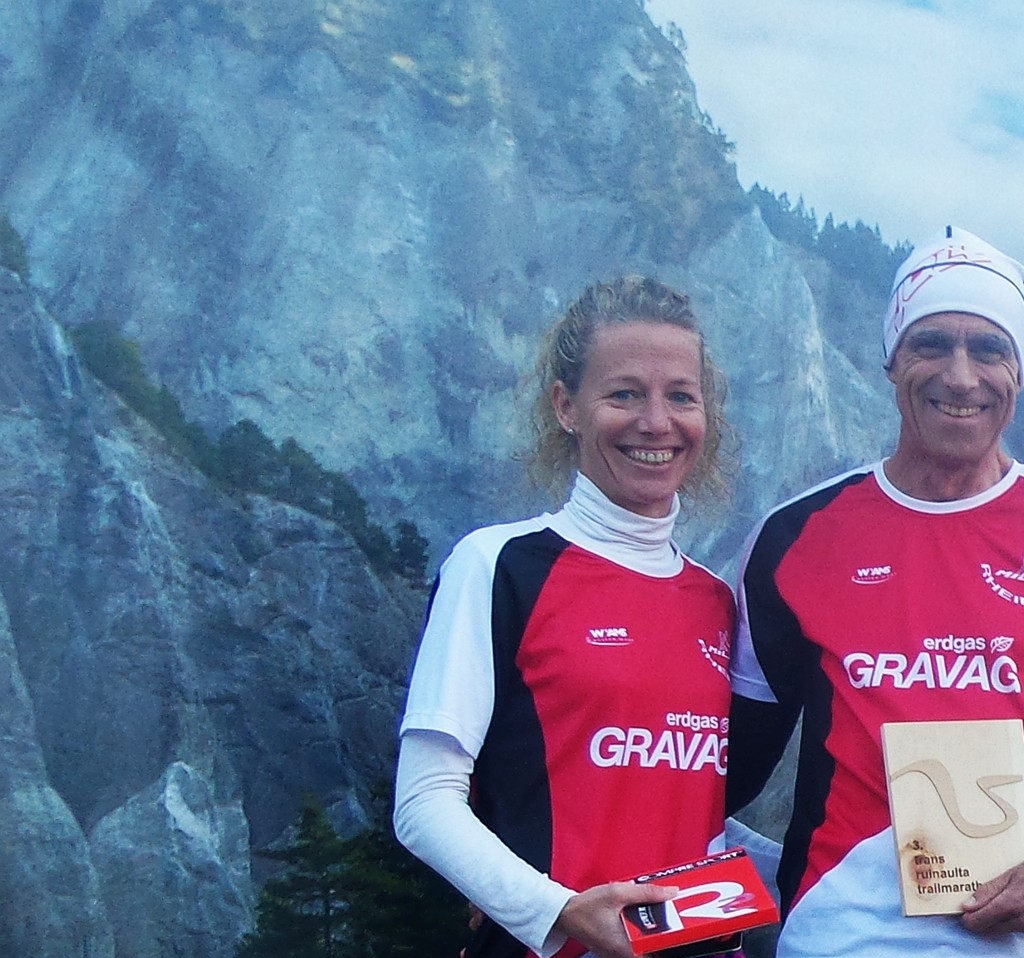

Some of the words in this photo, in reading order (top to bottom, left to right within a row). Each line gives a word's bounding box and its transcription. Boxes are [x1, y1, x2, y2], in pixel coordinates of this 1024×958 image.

[923, 634, 986, 657] erdgas
[843, 652, 1021, 694] GRAVAG
[666, 710, 719, 731] erdgas
[912, 840, 924, 851] 3.
[914, 855, 946, 866] trans
[915, 867, 970, 880] ruinaulta
[917, 880, 983, 895] trailmarath
